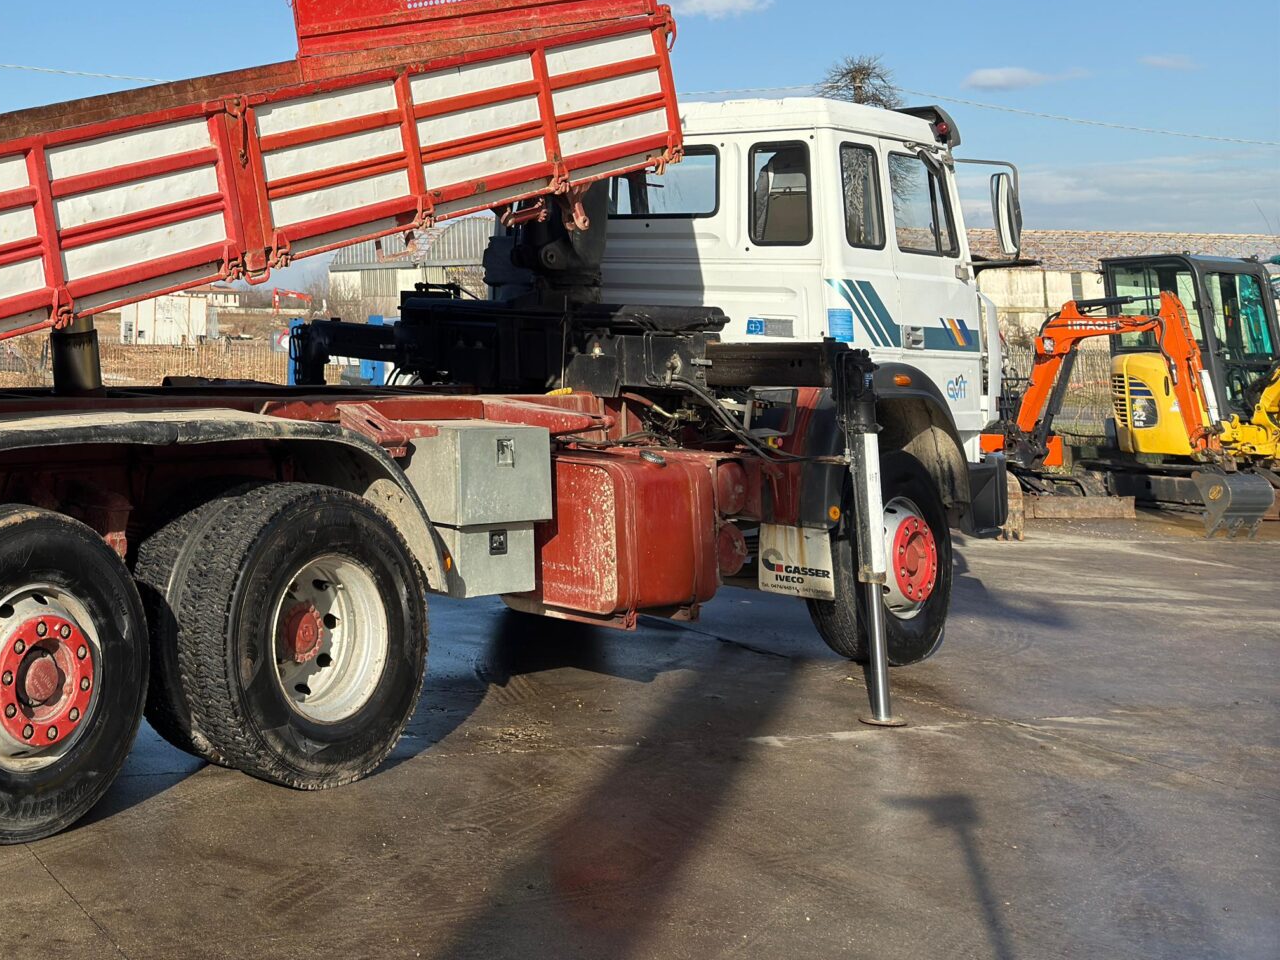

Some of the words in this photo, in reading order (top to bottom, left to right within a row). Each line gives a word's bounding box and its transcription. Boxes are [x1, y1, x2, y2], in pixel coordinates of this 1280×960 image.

[1133, 411, 1146, 420] 22
[784, 565, 831, 579] GASSER
[775, 574, 804, 584] IVECO
